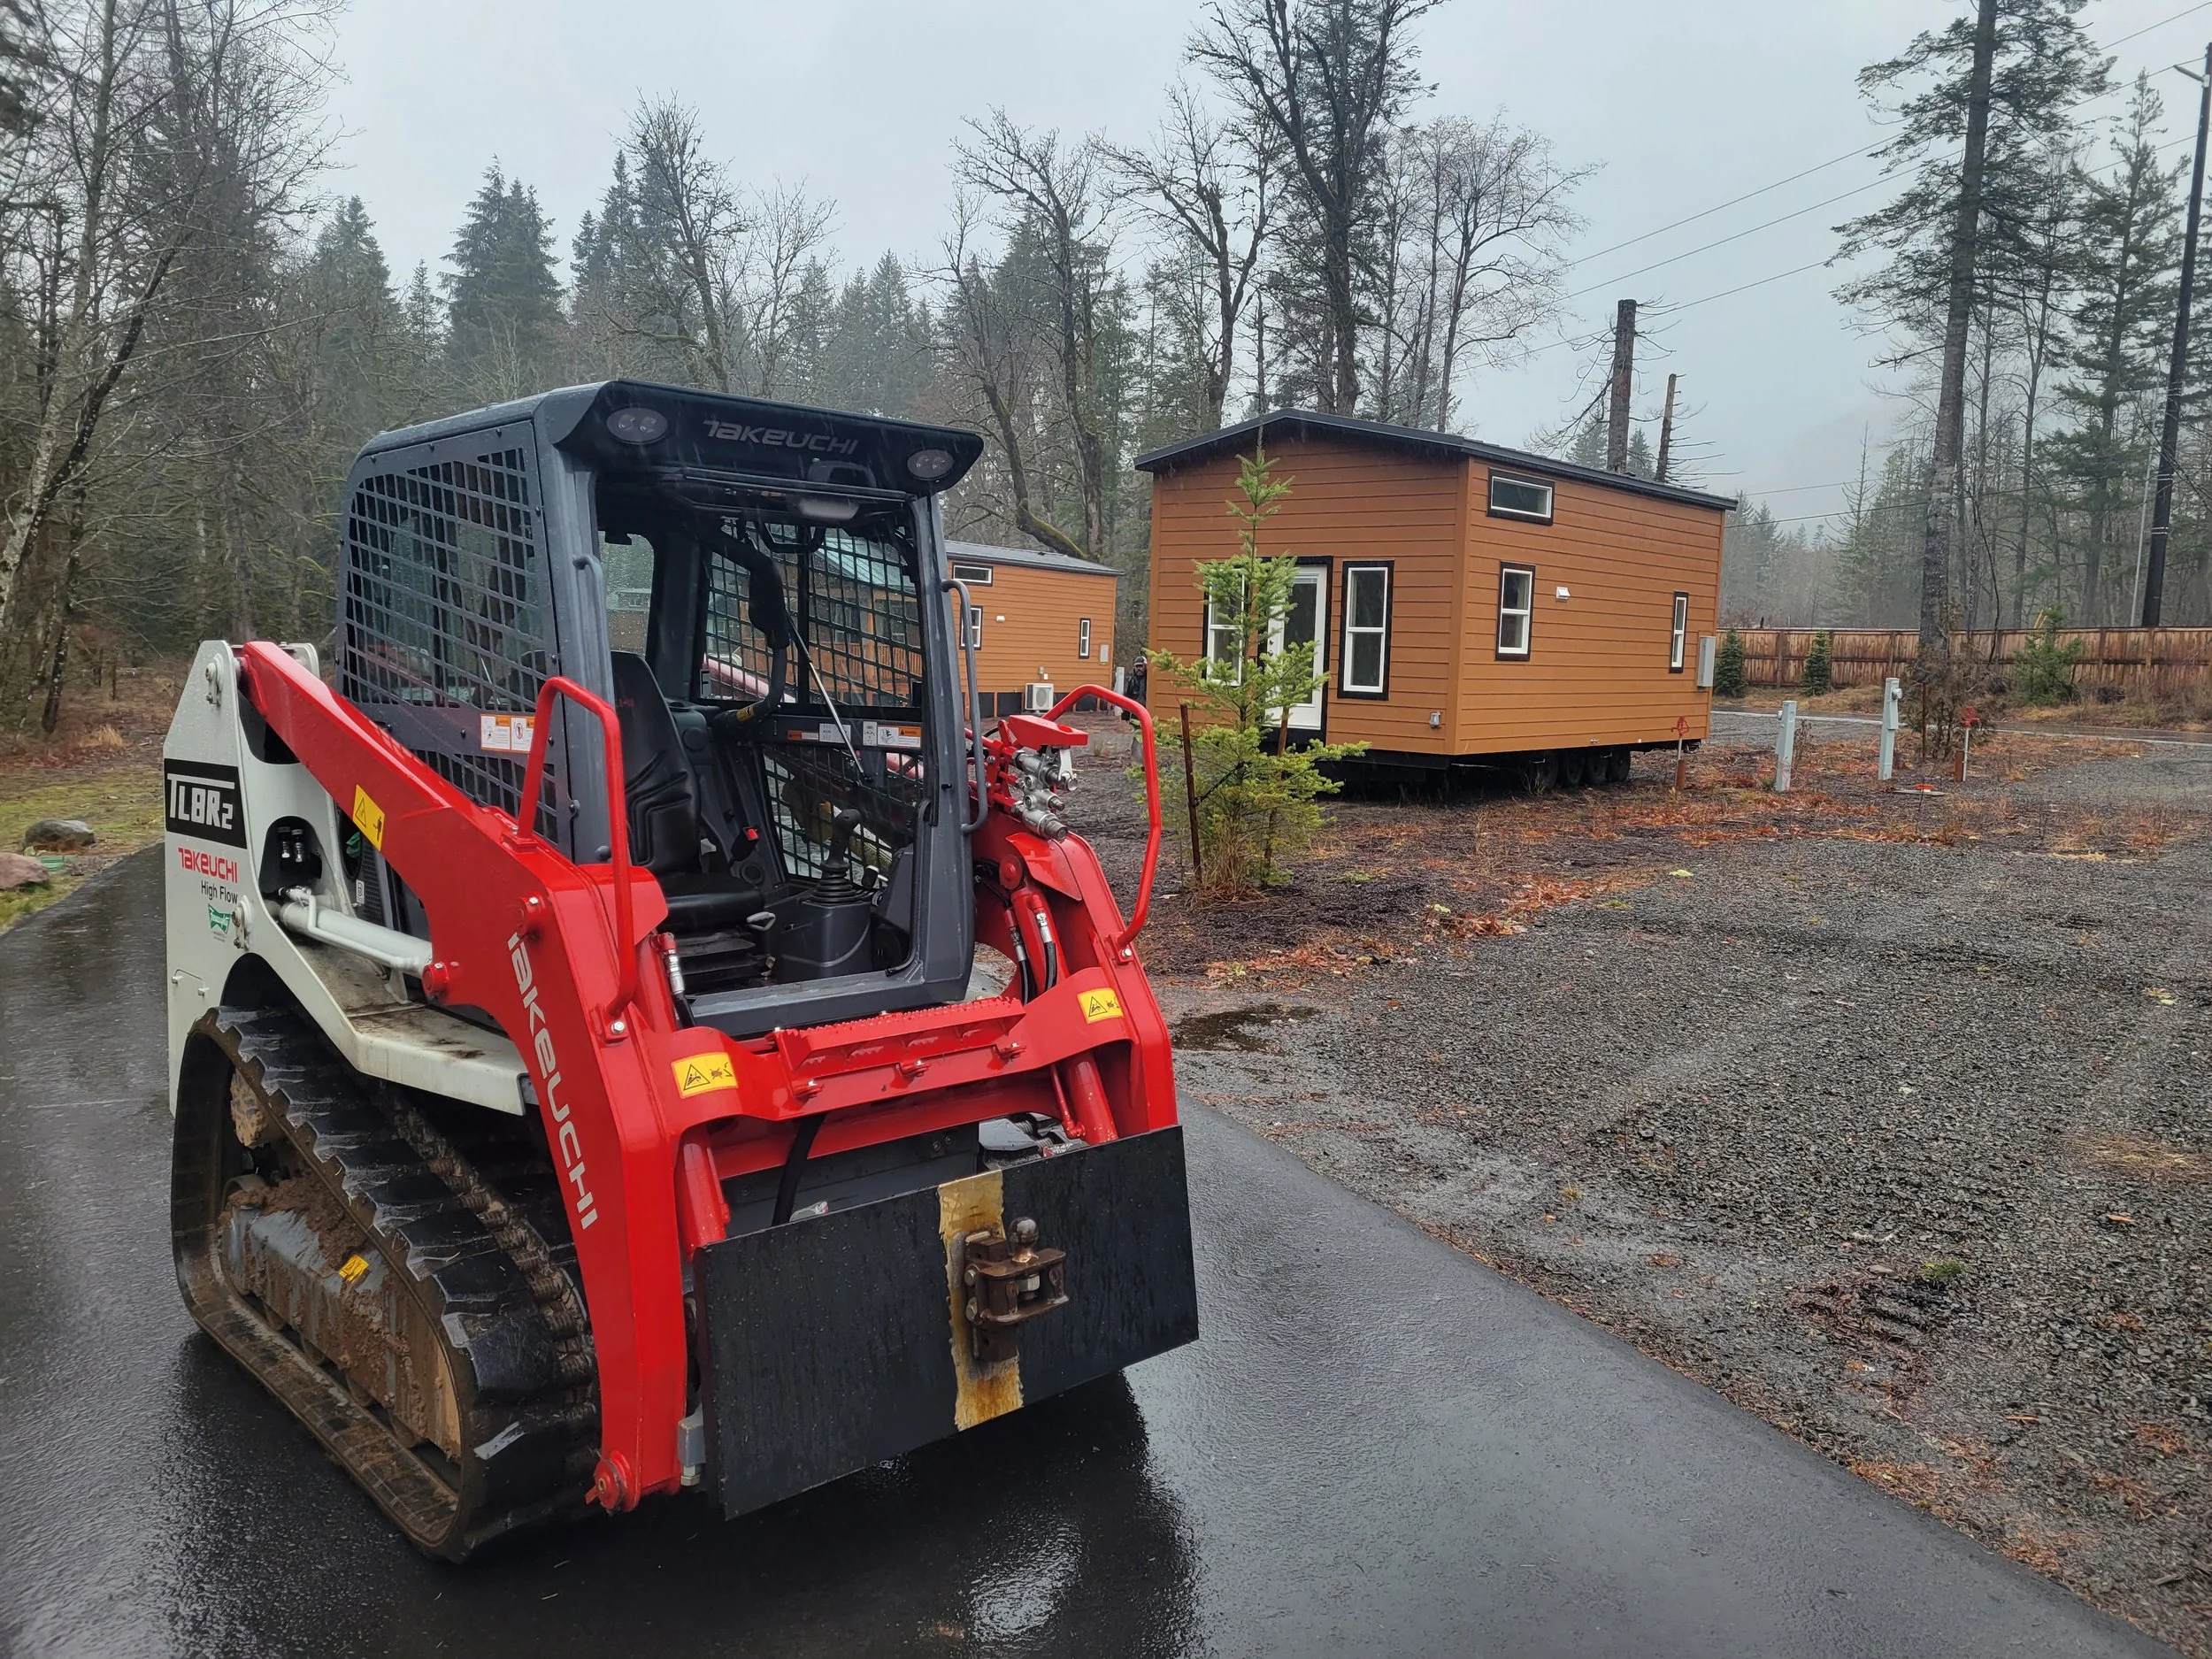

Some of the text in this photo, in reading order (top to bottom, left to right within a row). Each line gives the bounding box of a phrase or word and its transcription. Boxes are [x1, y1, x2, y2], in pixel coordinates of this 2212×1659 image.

[703, 419, 858, 455] TAKEUCHI
[178, 848, 237, 883] TAKEUCHI
[201, 879, 238, 904] High Flow
